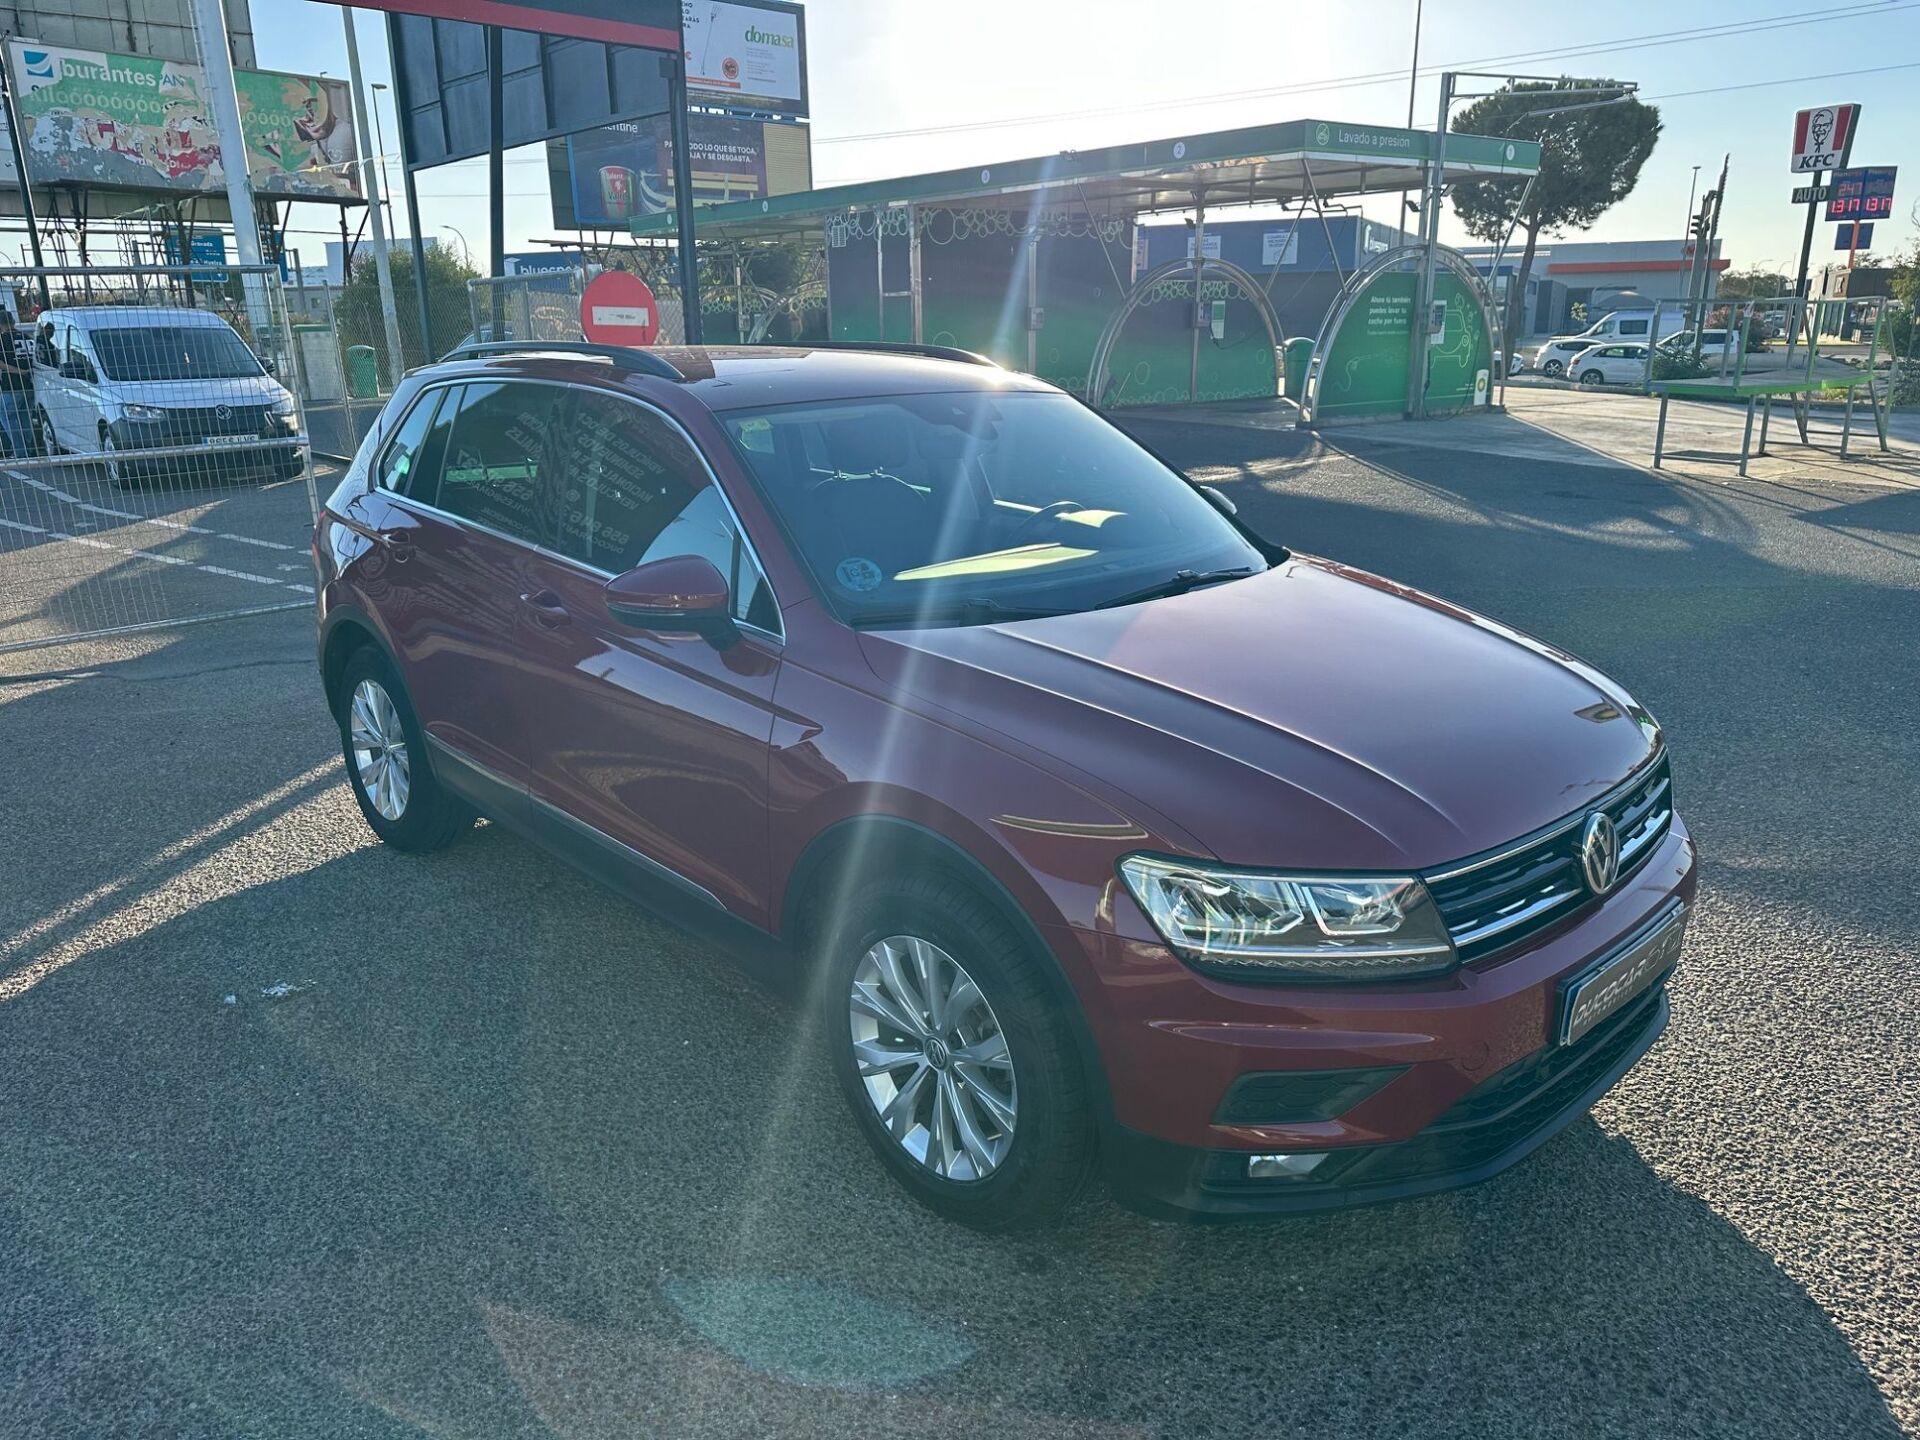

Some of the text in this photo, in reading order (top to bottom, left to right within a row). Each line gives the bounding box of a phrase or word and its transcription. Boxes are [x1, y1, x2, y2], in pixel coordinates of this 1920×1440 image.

[745, 25, 794, 48] domasa
[1339, 129, 1370, 144] Lavado
[1372, 135, 1377, 144] a
[714, 145, 728, 153] QUE
[1799, 153, 1835, 169] KFC
[1795, 187, 1827, 201] AUTO
